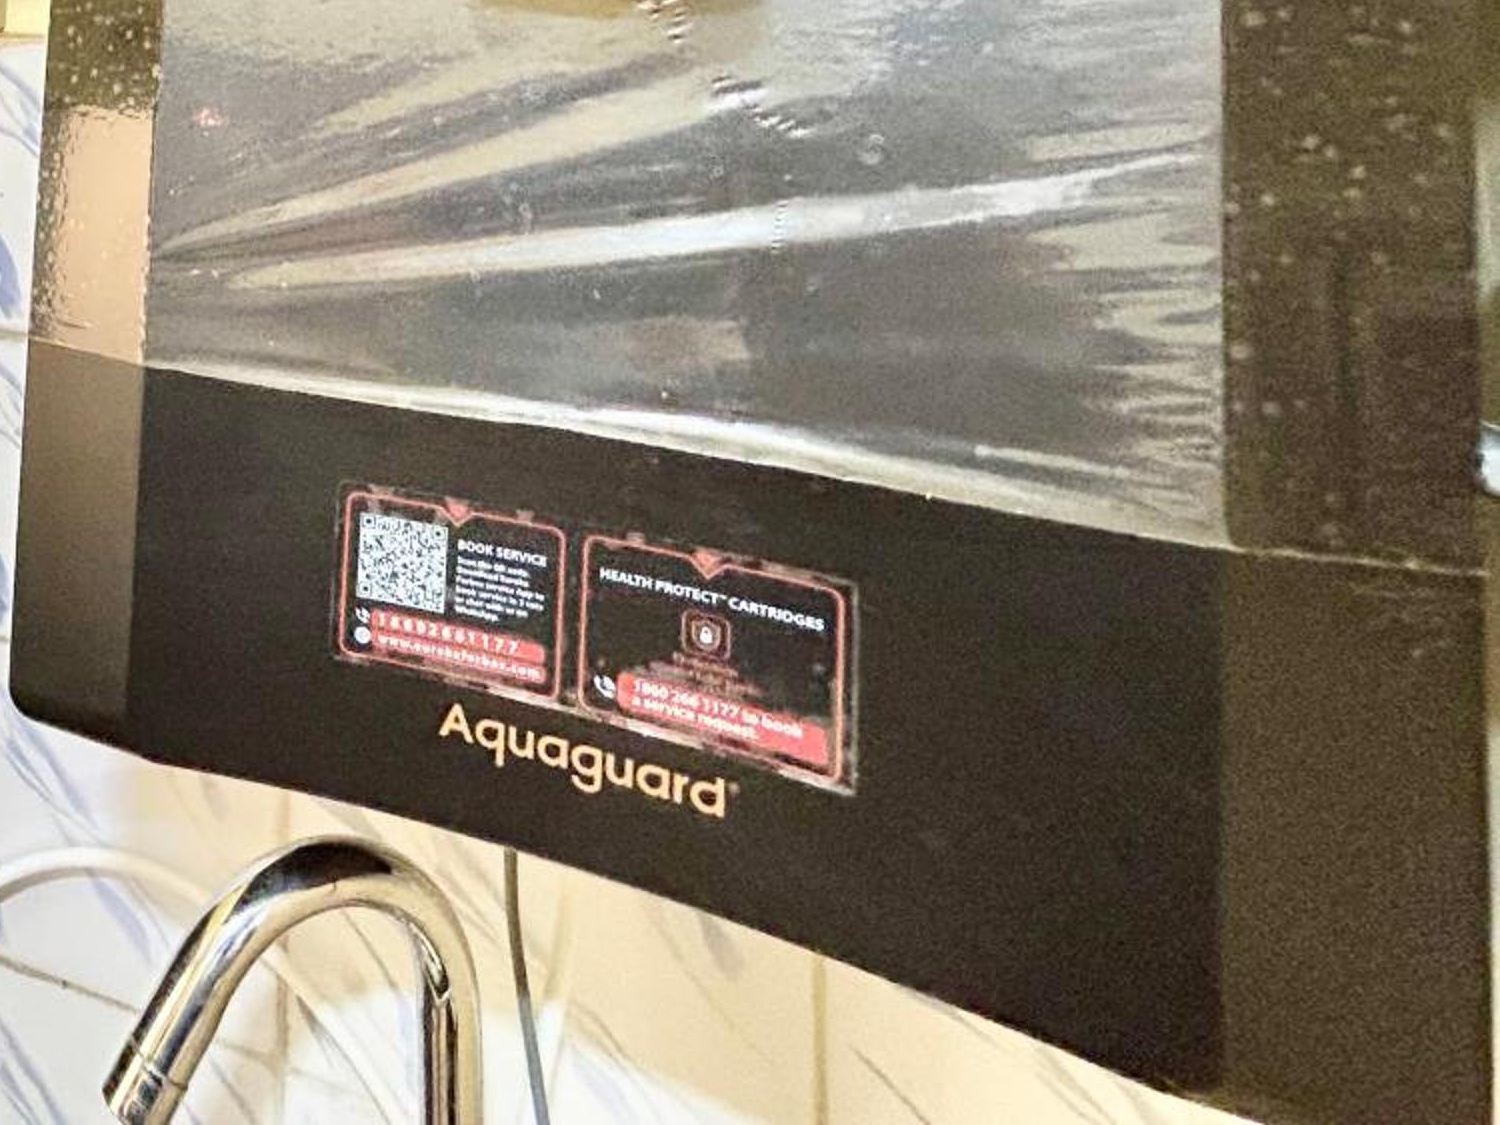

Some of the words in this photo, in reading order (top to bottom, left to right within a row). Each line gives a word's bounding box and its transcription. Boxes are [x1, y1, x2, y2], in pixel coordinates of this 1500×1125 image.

[457, 539, 493, 556] BOOK
[496, 546, 547, 567] SERVICE
[599, 567, 653, 590] HEALTH
[727, 597, 824, 632] CARTRIDGES
[643, 698, 695, 720] service
[701, 695, 740, 718] 1177
[760, 713, 803, 739] book
[439, 703, 726, 818] Aquaguard
